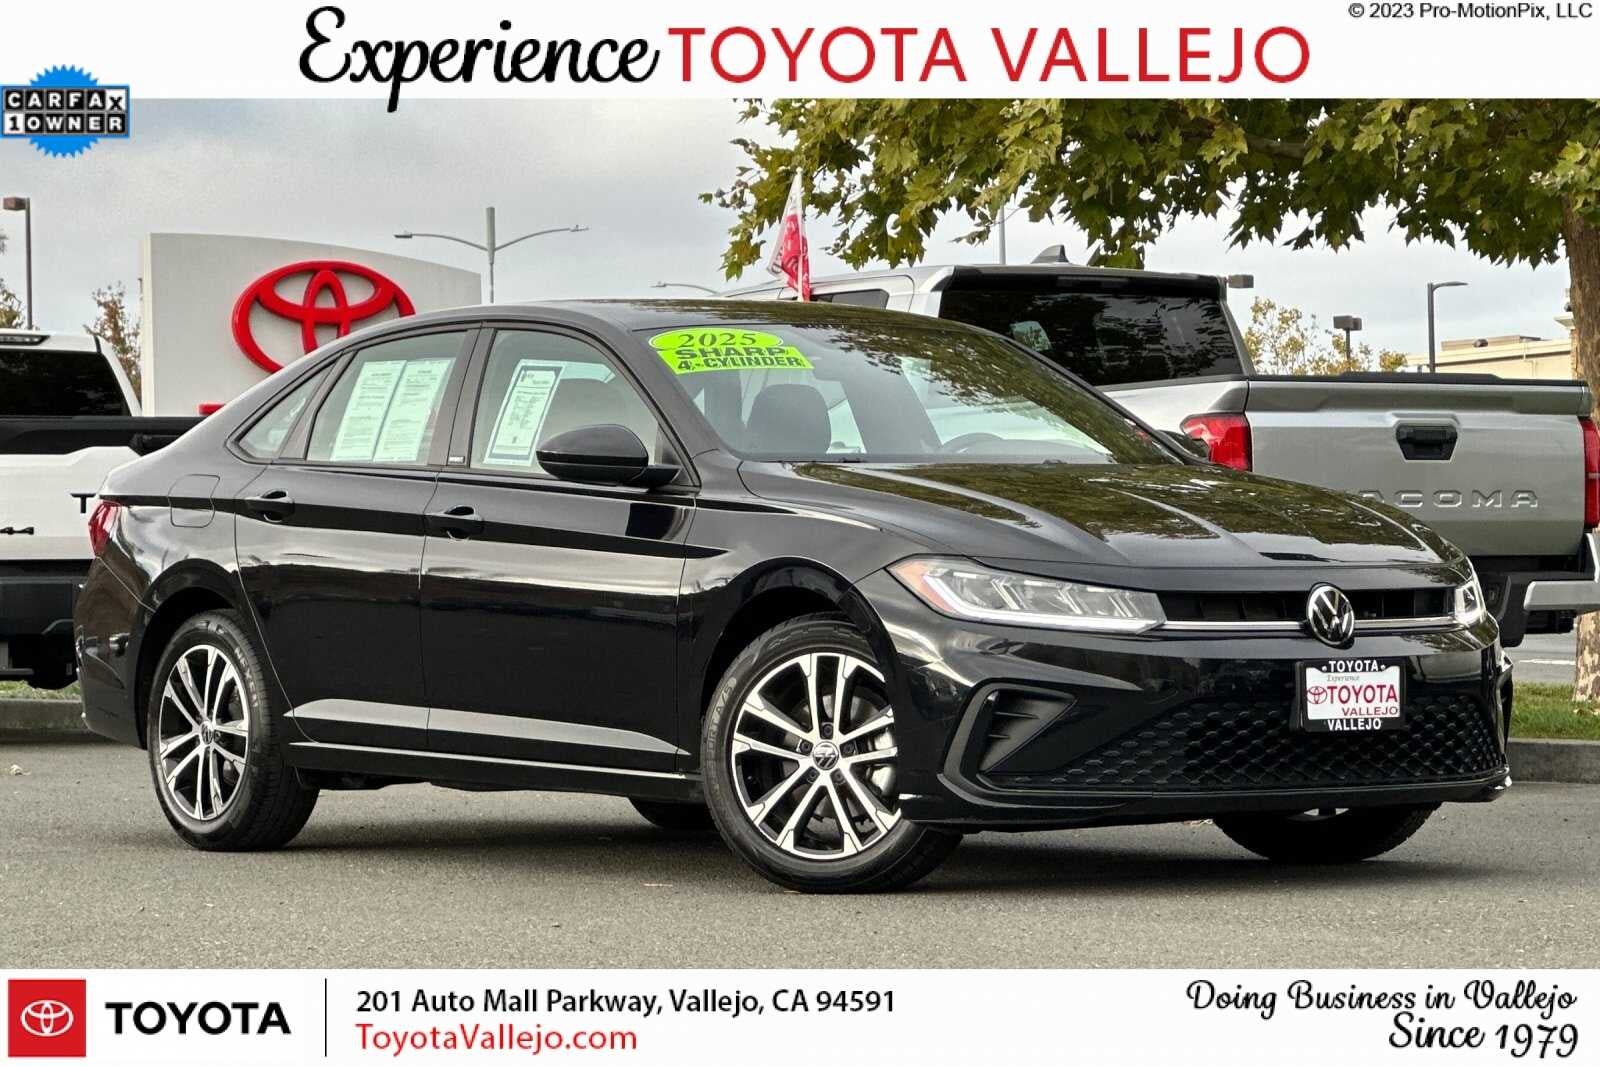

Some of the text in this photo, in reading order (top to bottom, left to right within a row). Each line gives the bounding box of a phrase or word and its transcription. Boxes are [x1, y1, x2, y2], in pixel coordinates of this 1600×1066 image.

[678, 332, 757, 348] 2025
[675, 347, 790, 359] SHARP
[1359, 489, 1538, 508] ACOMA
[1329, 660, 1379, 672] TOYOTA
[1327, 684, 1398, 704] TOYOTA
[1342, 706, 1399, 717] VALLEJO
[1328, 719, 1382, 731] VALLEJO
